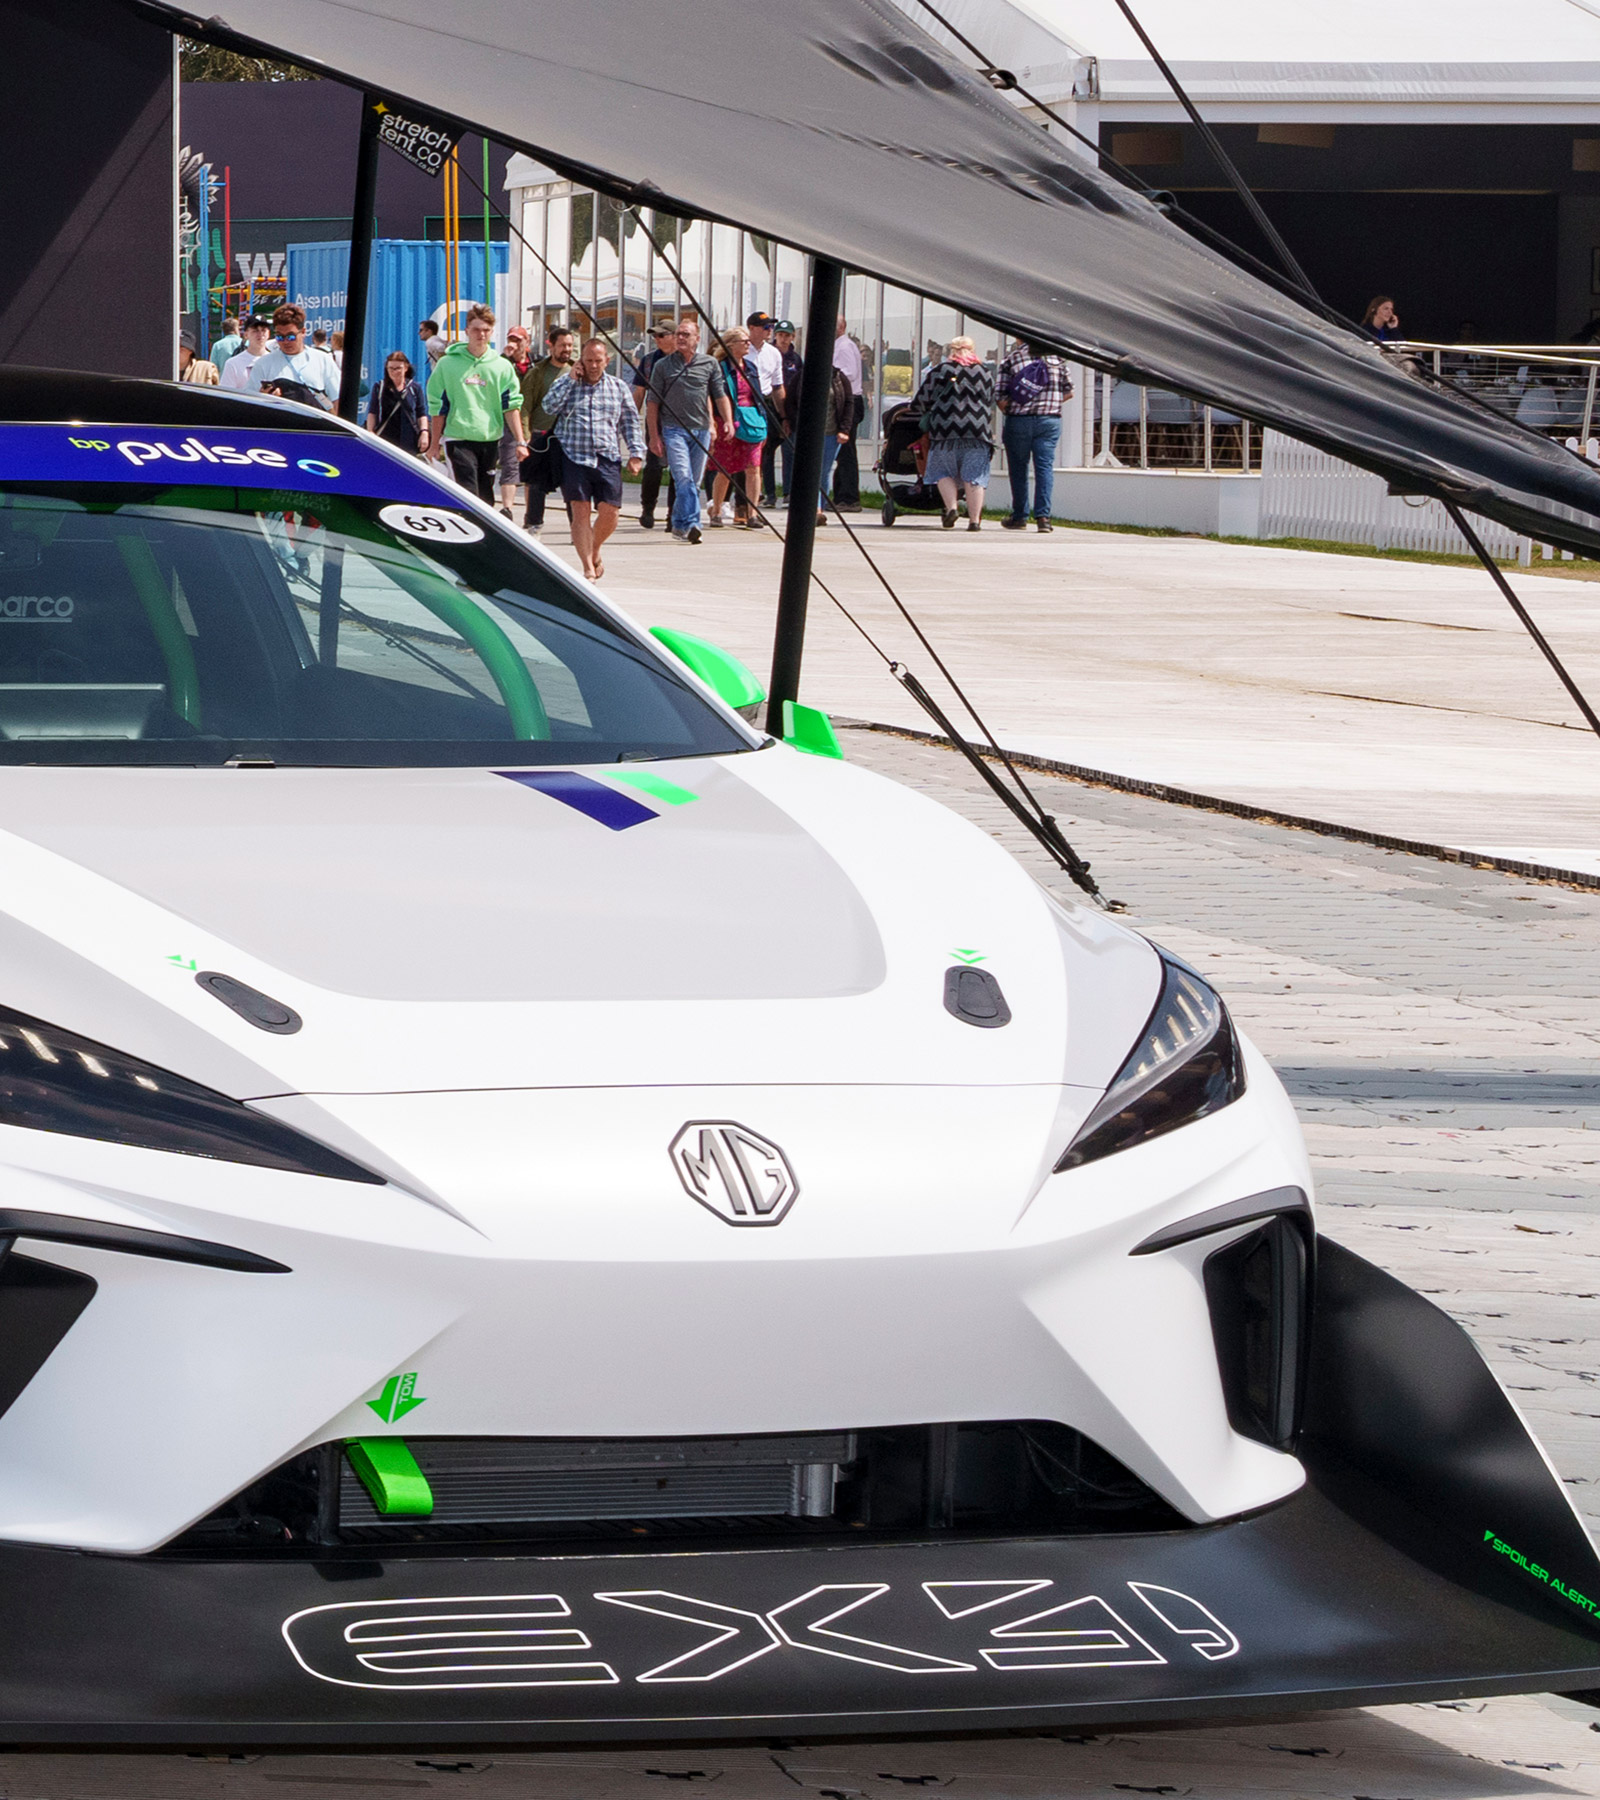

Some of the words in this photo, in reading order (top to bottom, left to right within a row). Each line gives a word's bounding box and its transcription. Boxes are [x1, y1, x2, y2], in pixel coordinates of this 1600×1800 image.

[380, 123, 417, 152] tent
[382, 114, 452, 153] stretch
[68, 437, 111, 452] bp
[117, 438, 289, 468] pulse
[403, 515, 470, 536] 691
[681, 1128, 787, 1215] MG
[398, 1374, 415, 1405] TOW
[1492, 1538, 1549, 1583] SPOILER
[1550, 1578, 1597, 1612] ALERT
